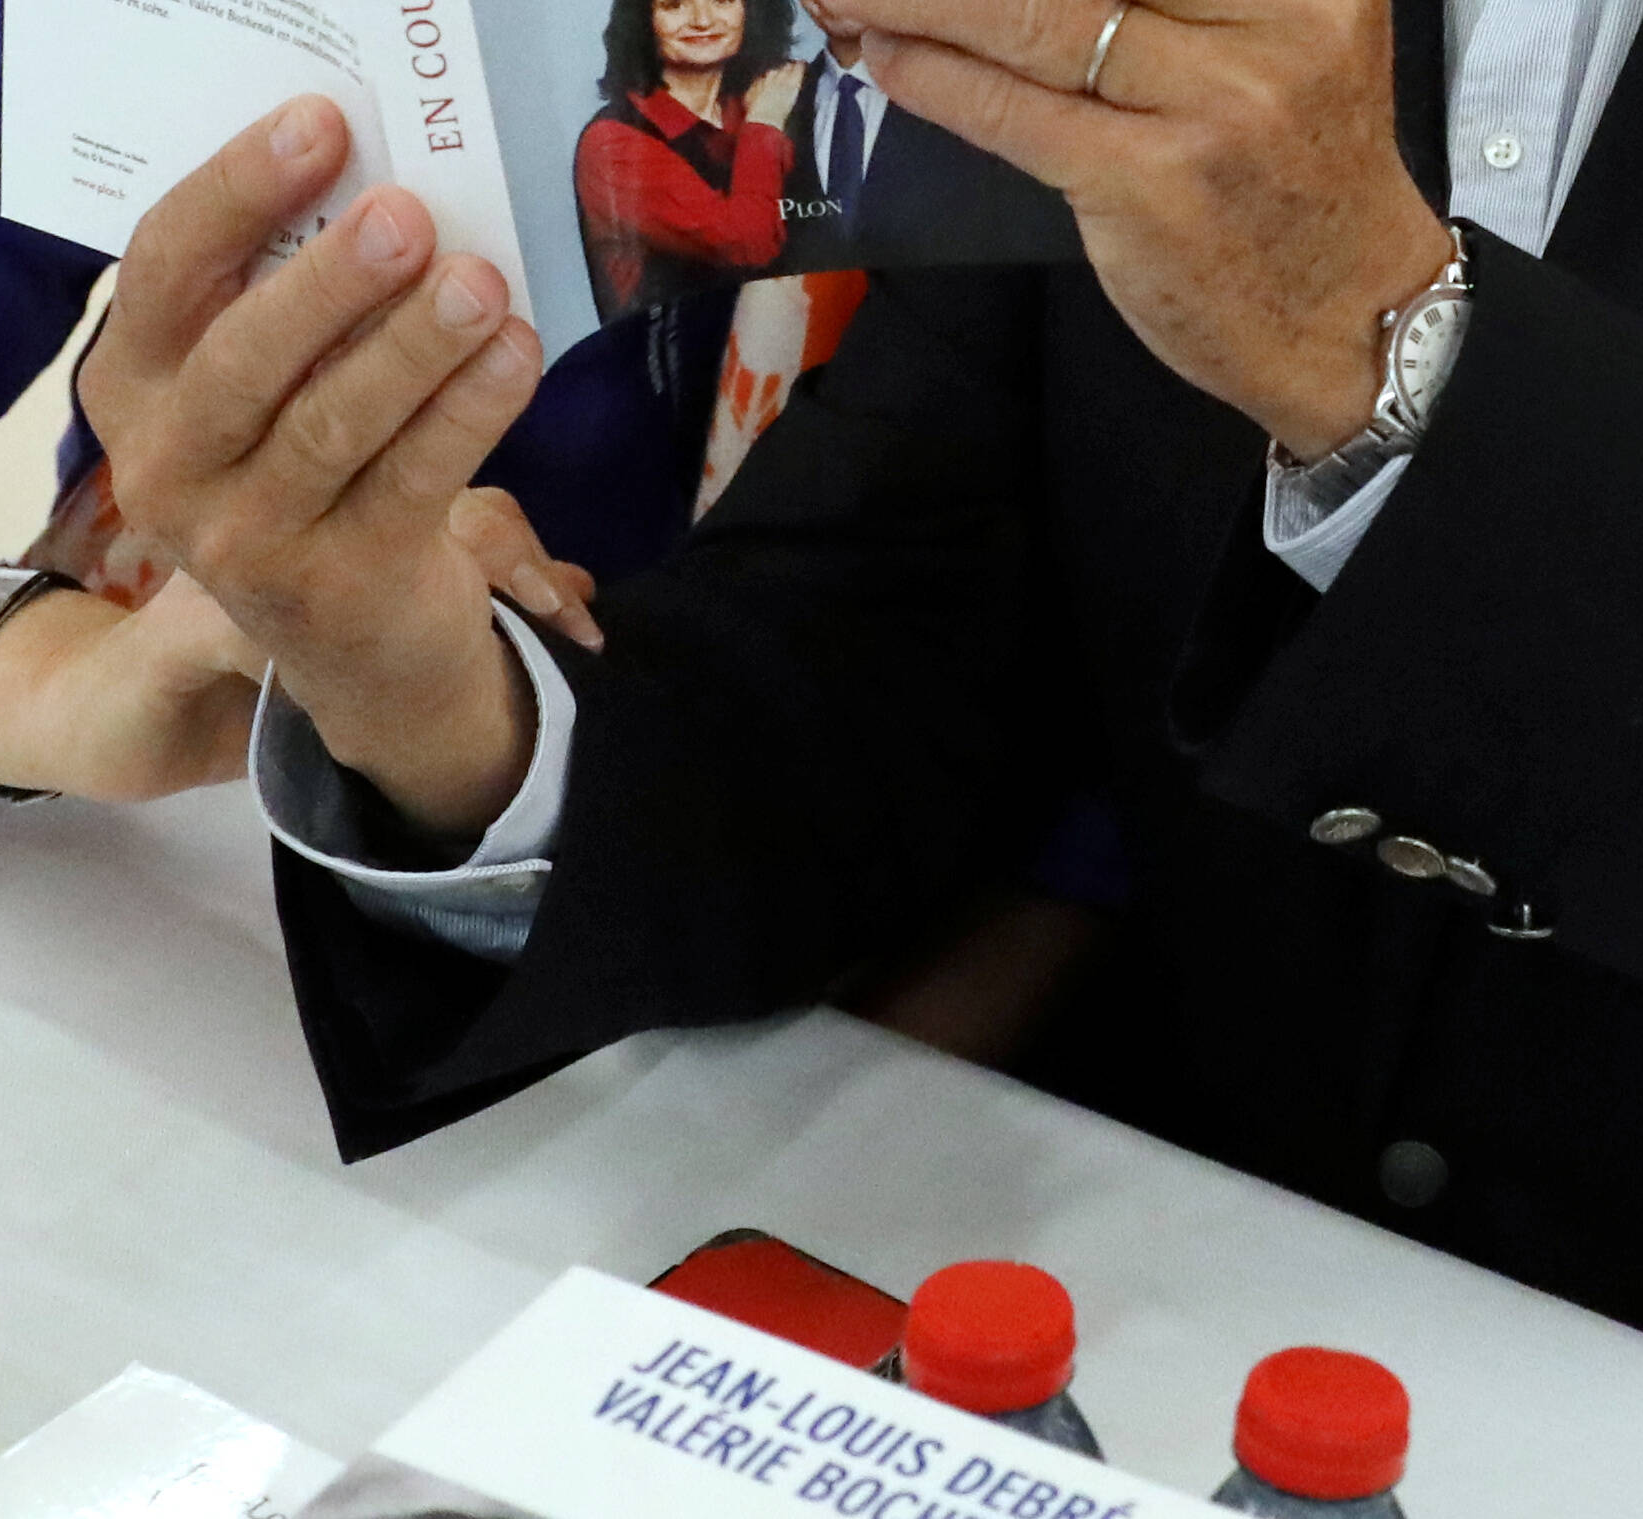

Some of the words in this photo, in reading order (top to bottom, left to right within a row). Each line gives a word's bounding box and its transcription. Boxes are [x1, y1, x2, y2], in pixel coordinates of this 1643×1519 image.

[420, 95, 464, 153] EN
[594, 1380, 803, 1485] VALÉRIE
[632, 1340, 946, 1477] JEAN-LOUIS
[943, 1456, 1135, 1519] DEBR
